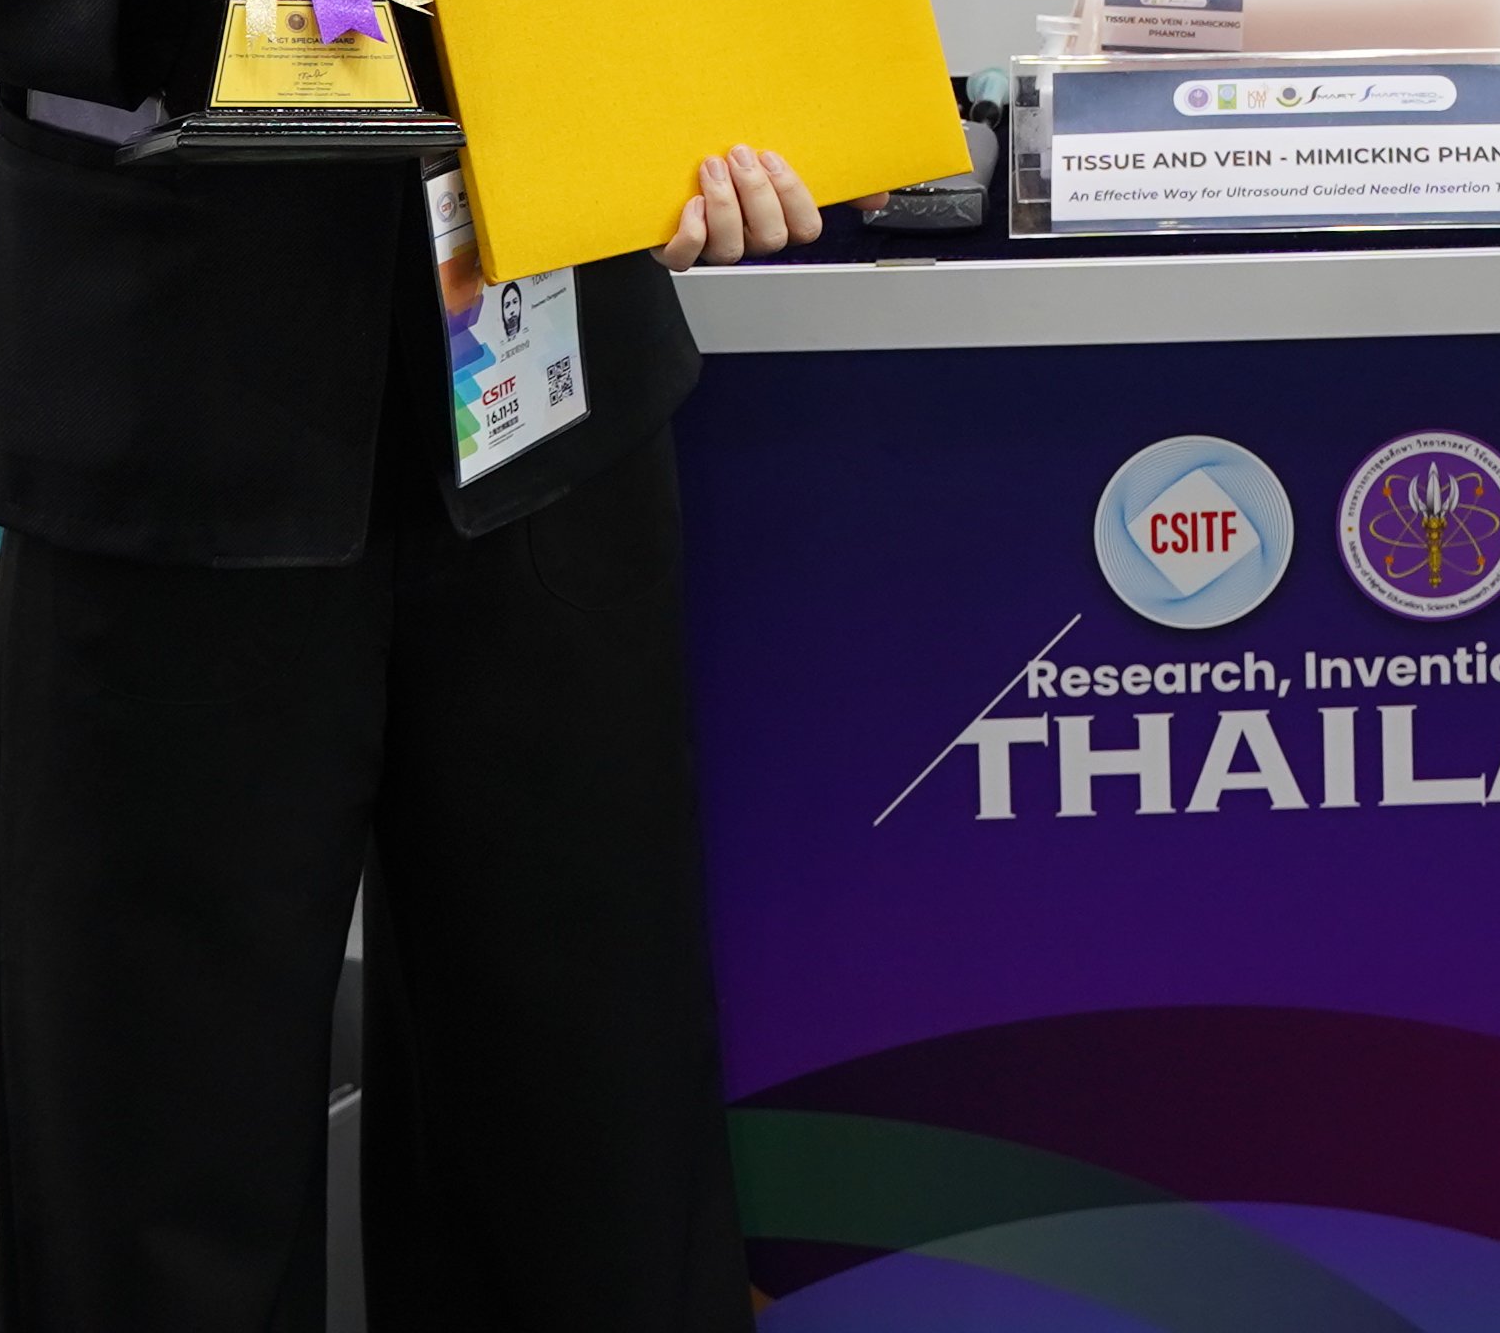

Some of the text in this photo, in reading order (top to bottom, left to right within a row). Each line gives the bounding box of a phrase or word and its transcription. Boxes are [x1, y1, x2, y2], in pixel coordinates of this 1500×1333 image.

[1105, 16, 1241, 27] TISSUE AND VEIN MIMICKING
[1148, 29, 1196, 38] PHANTOM
[1061, 151, 1146, 172] TISSUE
[1152, 149, 1207, 169] AND
[1213, 148, 1272, 167] VEIN
[1295, 145, 1432, 166] MIMICKING
[1068, 190, 1090, 202] An
[1093, 188, 1160, 202] Effective
[1163, 187, 1197, 203] Way
[1200, 186, 1222, 199] for
[1226, 184, 1309, 199] Ultrasound
[1312, 183, 1365, 197] Guided
[1370, 182, 1421, 196] Needle
[1425, 181, 1490, 195] Insertion
[482, 375, 517, 407] CSITF
[1149, 511, 1238, 556] CSITF
[1025, 651, 1293, 702] Research,
